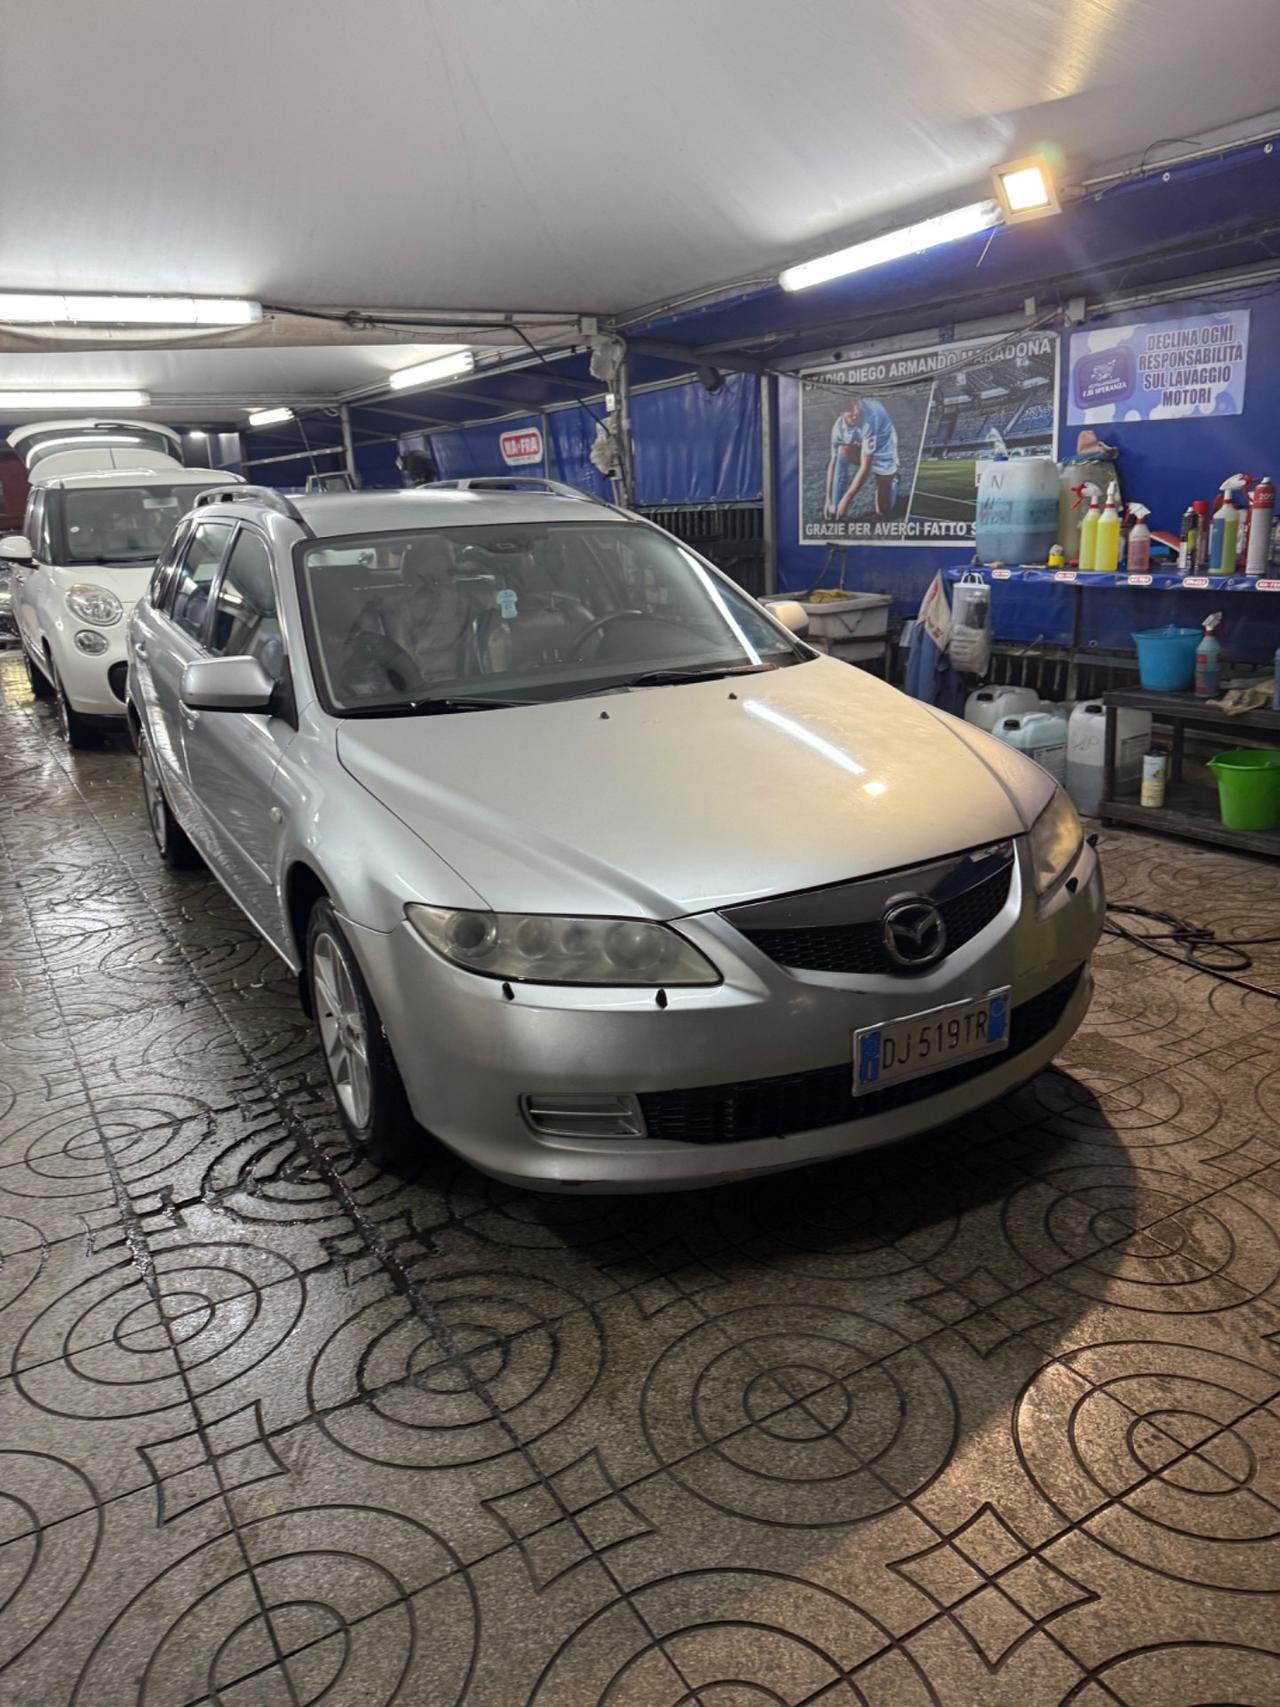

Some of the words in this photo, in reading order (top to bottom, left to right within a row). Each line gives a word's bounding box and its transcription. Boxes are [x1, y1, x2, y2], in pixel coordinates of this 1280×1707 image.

[1148, 331, 1198, 350] DECLINA
[1202, 325, 1233, 342] OGNI
[848, 365, 886, 384] DIEGO
[889, 352, 956, 377] ARMANDO
[1139, 342, 1242, 370] RESPONSABILITÀ
[1144, 370, 1165, 389] SUL
[1168, 365, 1232, 387] LAVAGGIO
[1162, 387, 1211, 407] MOTORI
[805, 523, 845, 536] GRAZIE
[848, 522, 871, 536] PER
[873, 521, 920, 536] AVERCI
[923, 521, 967, 536] FATTO
